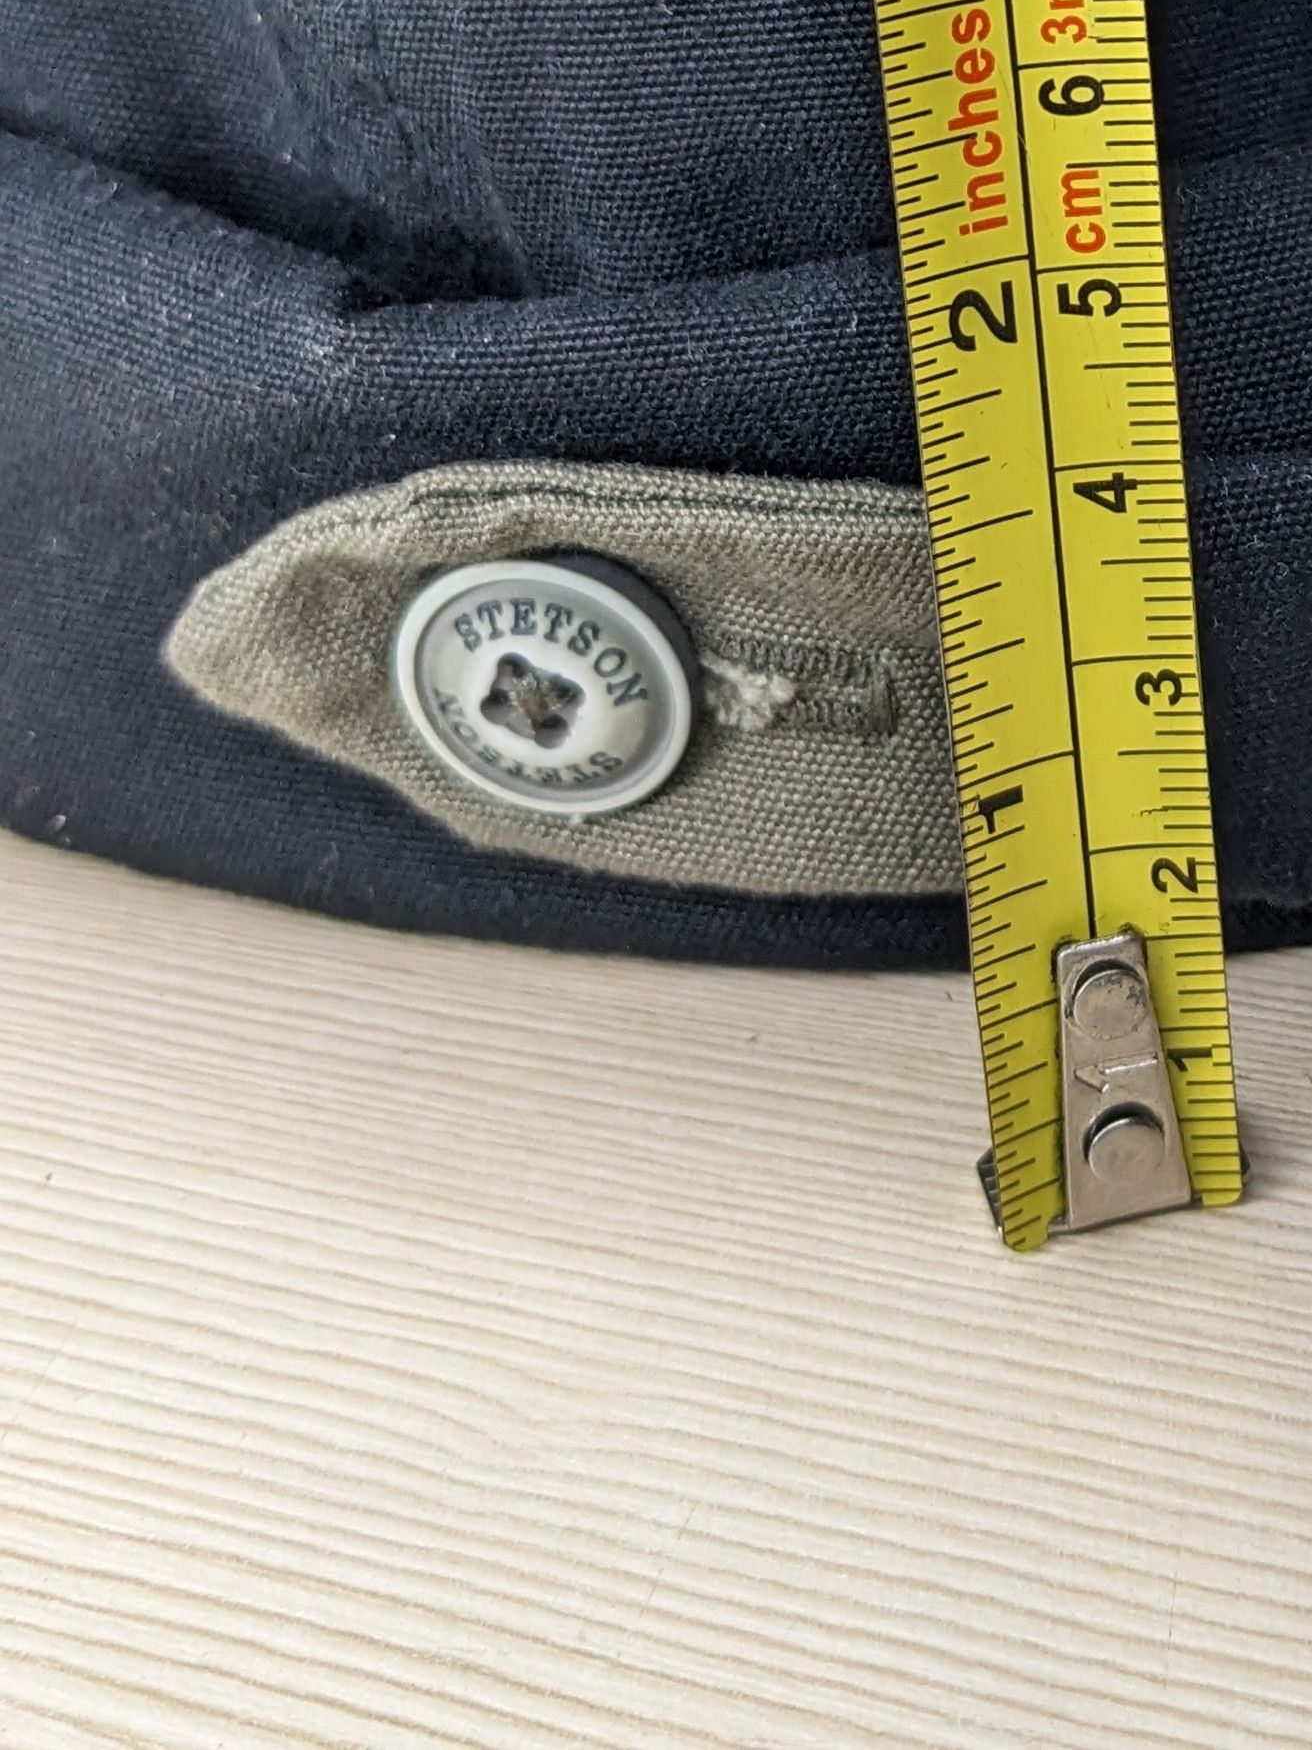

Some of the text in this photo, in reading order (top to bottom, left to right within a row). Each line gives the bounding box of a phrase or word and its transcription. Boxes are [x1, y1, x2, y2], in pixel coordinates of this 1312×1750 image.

[1038, 74, 1105, 117] 6
[948, 7, 1009, 236] inches
[1061, 168, 1107, 254] cm
[949, 279, 1018, 352] 2
[1056, 277, 1122, 318] 5
[1072, 472, 1138, 513] 4
[453, 596, 650, 708] STETSON
[1135, 668, 1182, 706] 3
[968, 784, 1024, 835] 1
[1151, 856, 1199, 894] 2
[1168, 1046, 1213, 1072] 1
